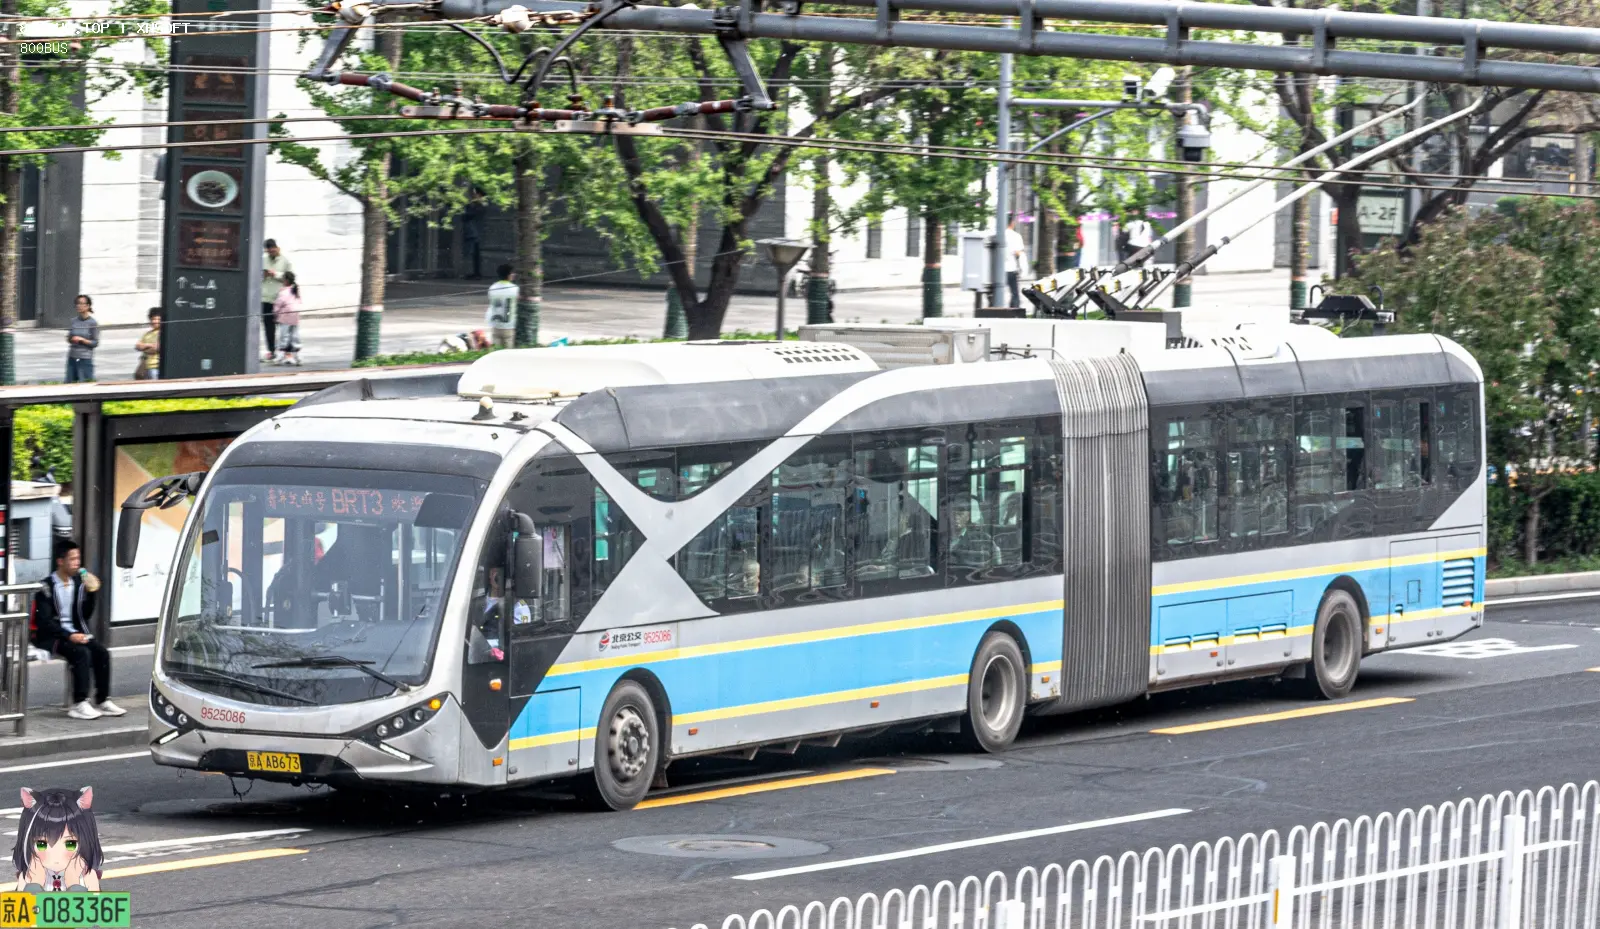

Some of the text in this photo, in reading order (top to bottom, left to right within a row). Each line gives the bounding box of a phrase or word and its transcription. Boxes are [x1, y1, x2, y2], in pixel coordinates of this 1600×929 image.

[331, 488, 383, 515] BRT3
[612, 629, 672, 645] 北京公交 9525086
[201, 706, 246, 724] 9525086
